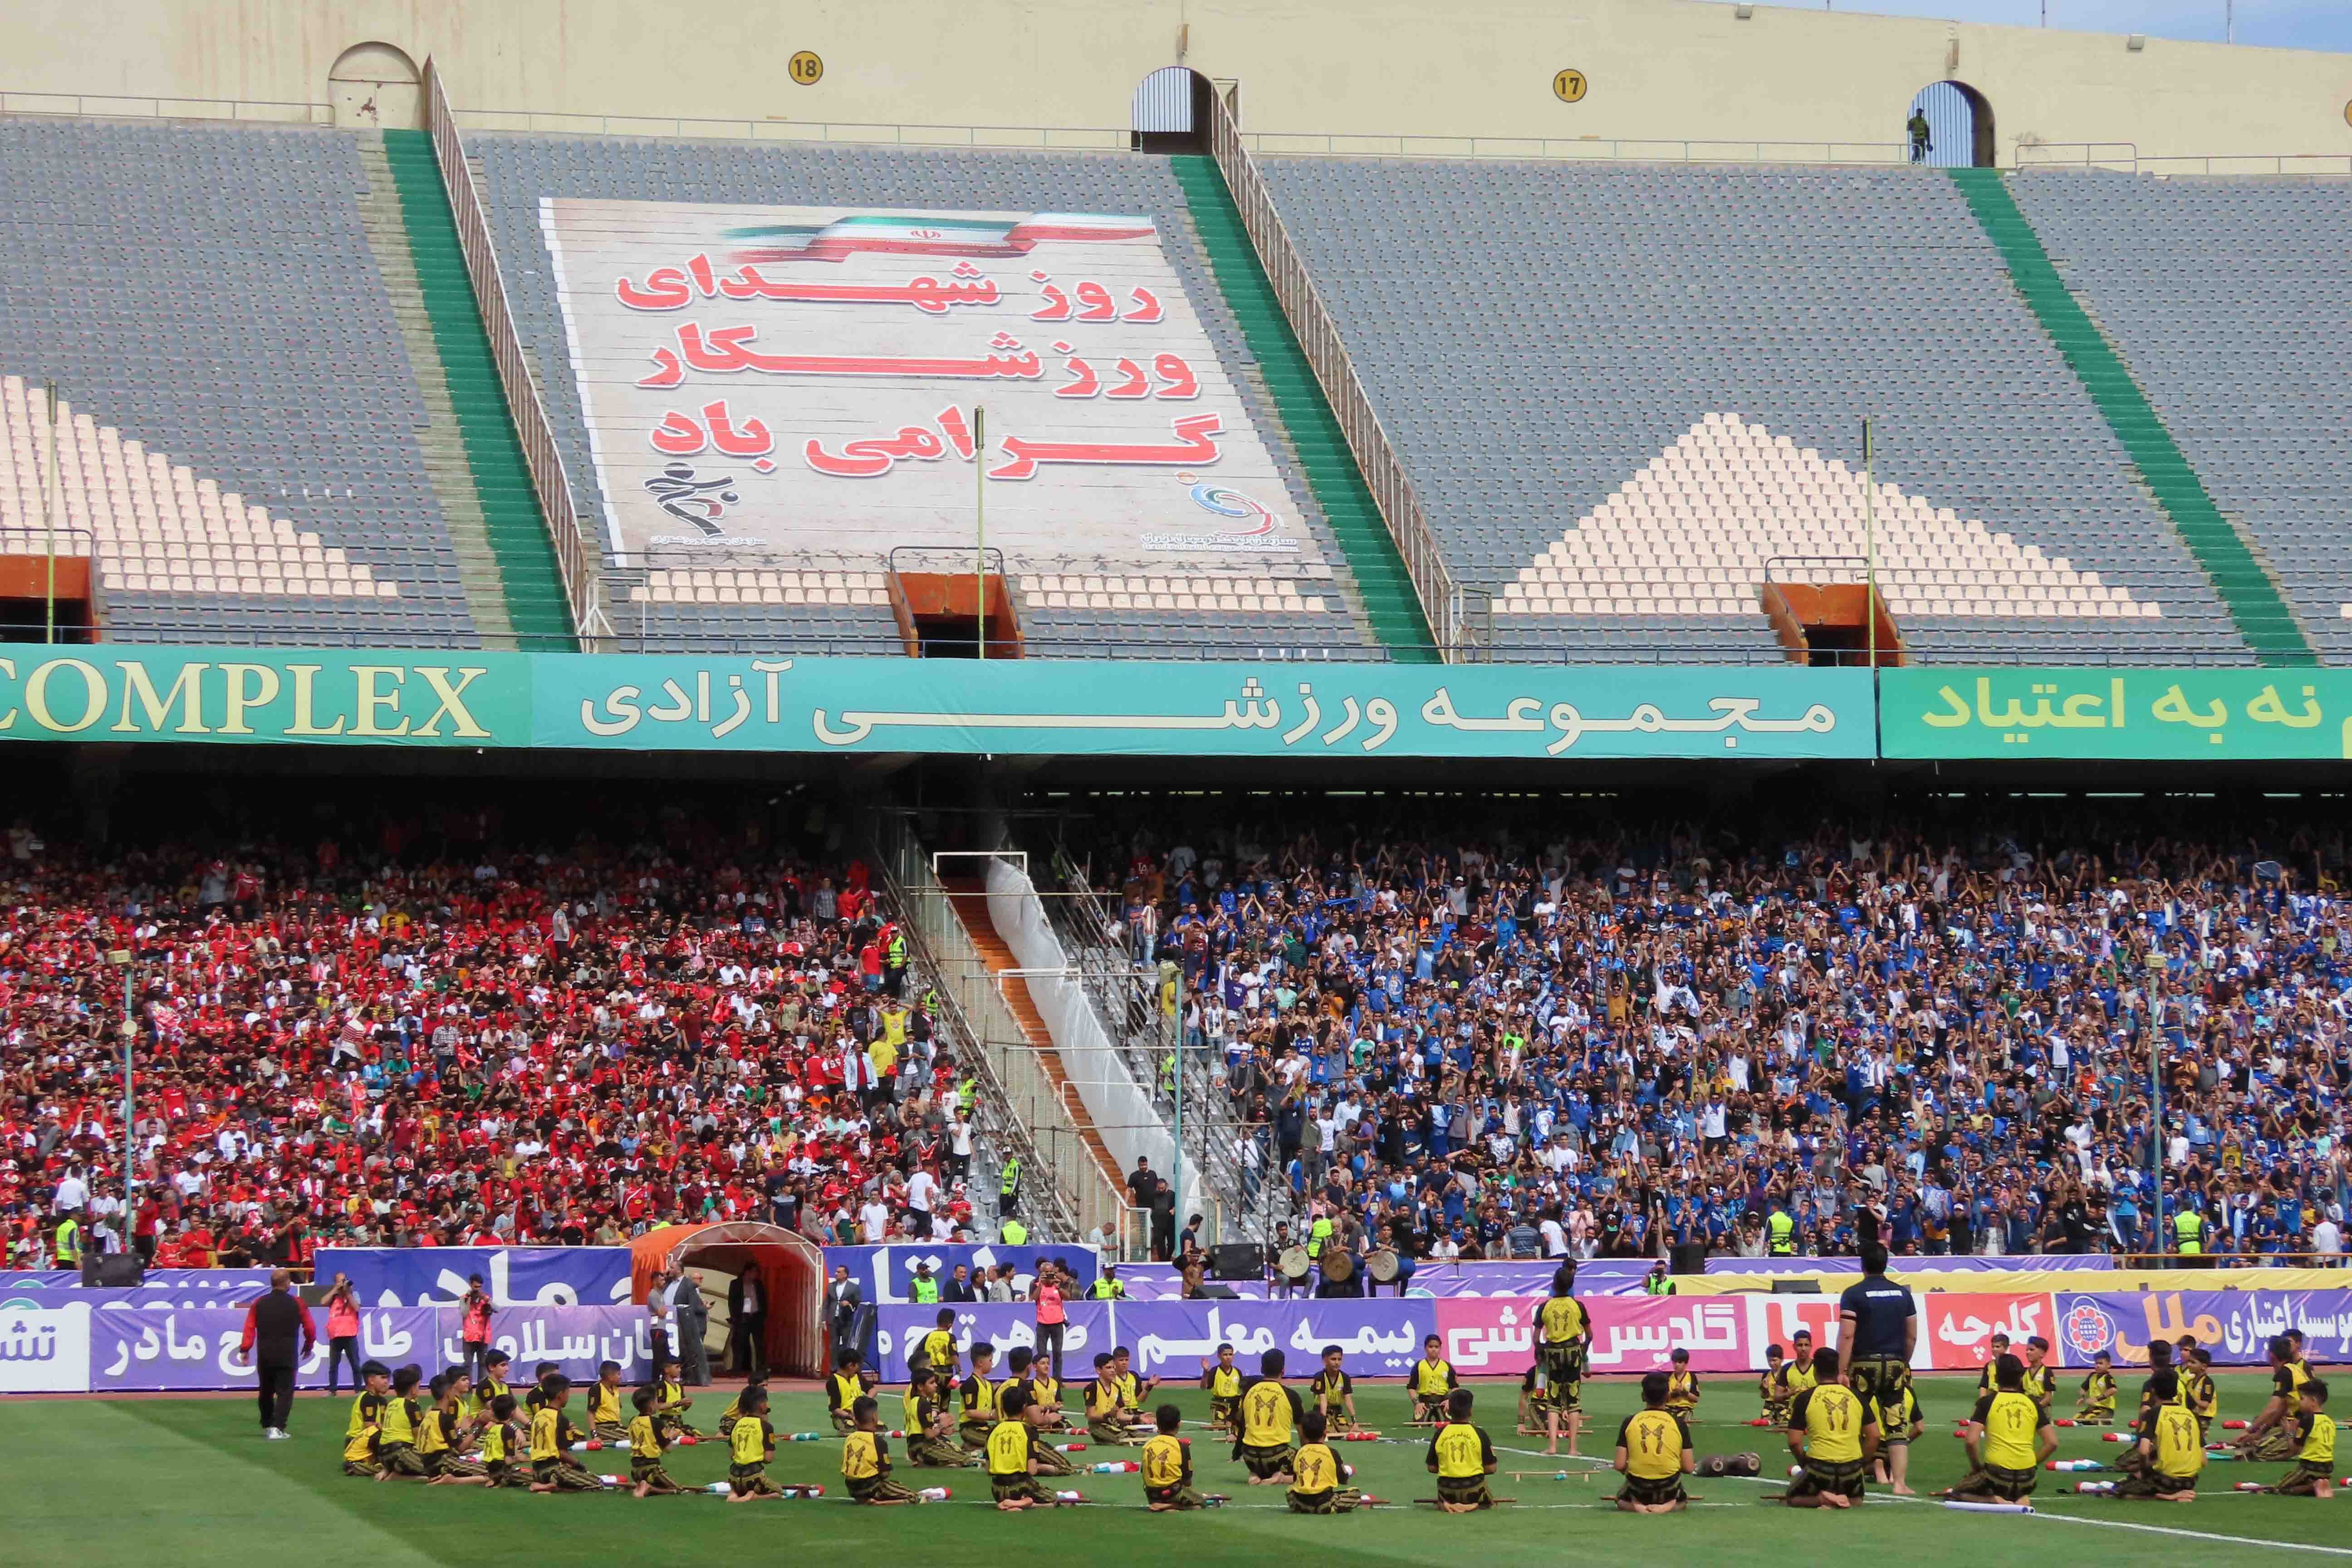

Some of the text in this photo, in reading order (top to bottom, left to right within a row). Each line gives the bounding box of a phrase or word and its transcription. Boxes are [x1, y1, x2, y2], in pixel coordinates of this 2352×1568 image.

[795, 59, 817, 77] 18
[1560, 77, 1580, 95] 17
[616, 252, 1165, 321] روز شهدای
[650, 399, 1226, 480] گرامی باد
[580, 658, 1836, 757] مجموعه ورزشی آزادی
[1921, 677, 2323, 744] نه به اعتیاد
[104, 1314, 206, 1376] مادر
[1137, 1306, 1416, 1373] بیمه معلم
[1938, 1301, 2041, 1361] کلوچه
[2297, 1304, 2352, 1354] وسسه
